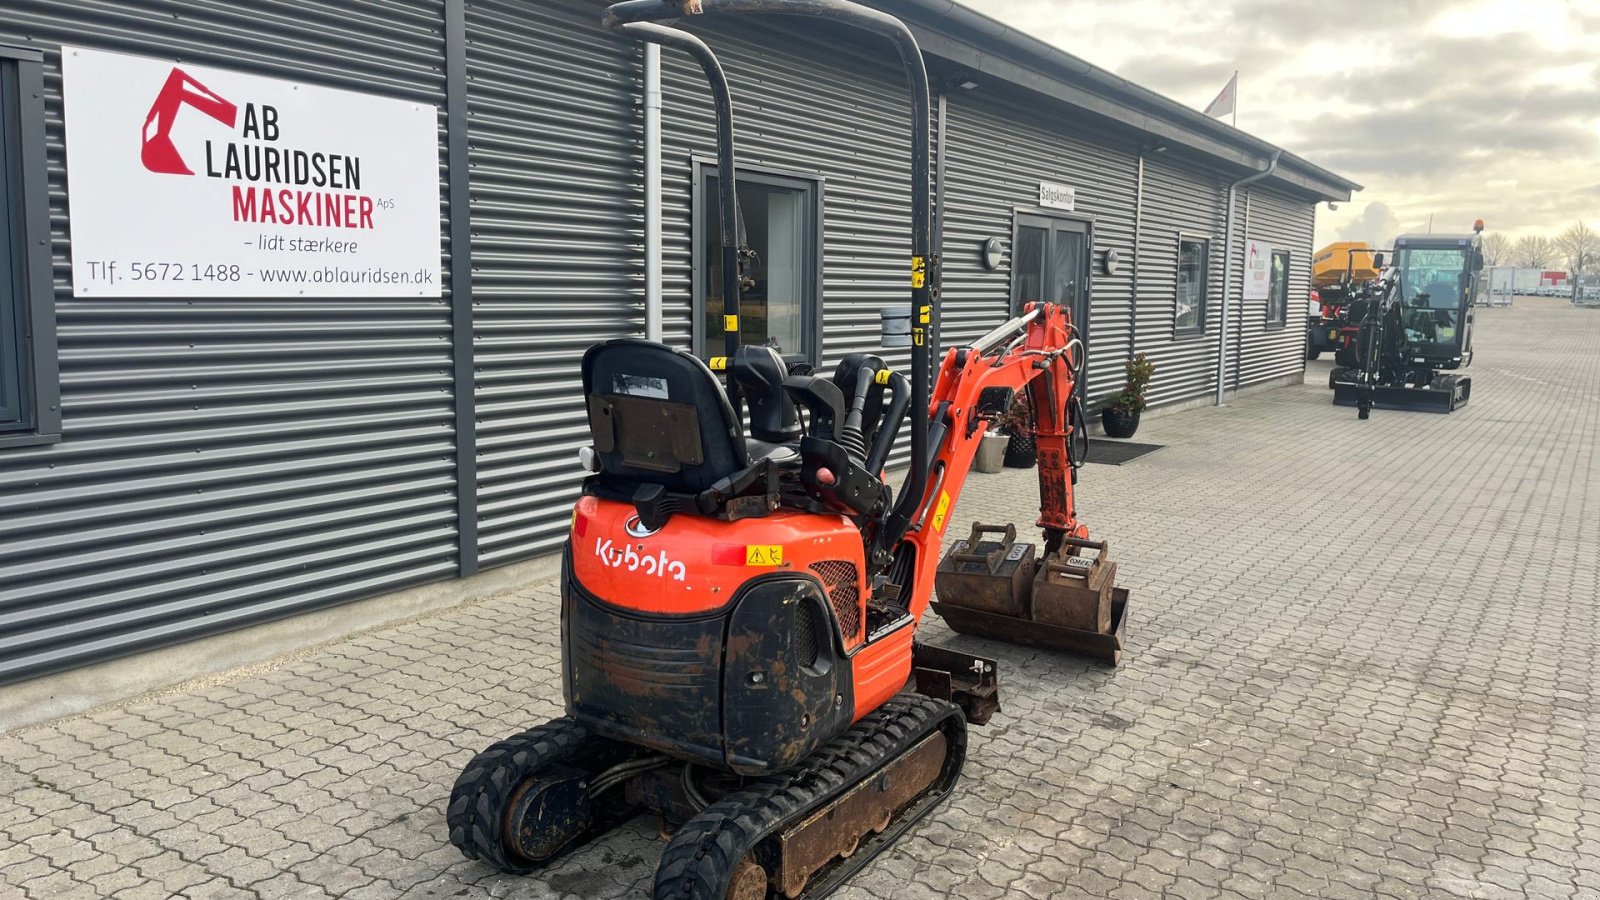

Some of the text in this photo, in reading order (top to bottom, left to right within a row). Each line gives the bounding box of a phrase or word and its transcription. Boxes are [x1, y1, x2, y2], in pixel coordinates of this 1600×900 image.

[242, 102, 280, 142] AB
[205, 139, 361, 190] LAURIDSEN
[232, 186, 395, 229] MASKINER ApS
[258, 233, 285, 251] lidt
[289, 237, 358, 254] stærkere
[86, 261, 123, 284] Tlf.
[131, 262, 184, 281] 5672
[191, 264, 241, 281] 1488
[259, 267, 433, 284] www.ablauridsen.dk
[595, 537, 686, 581] Kubota
